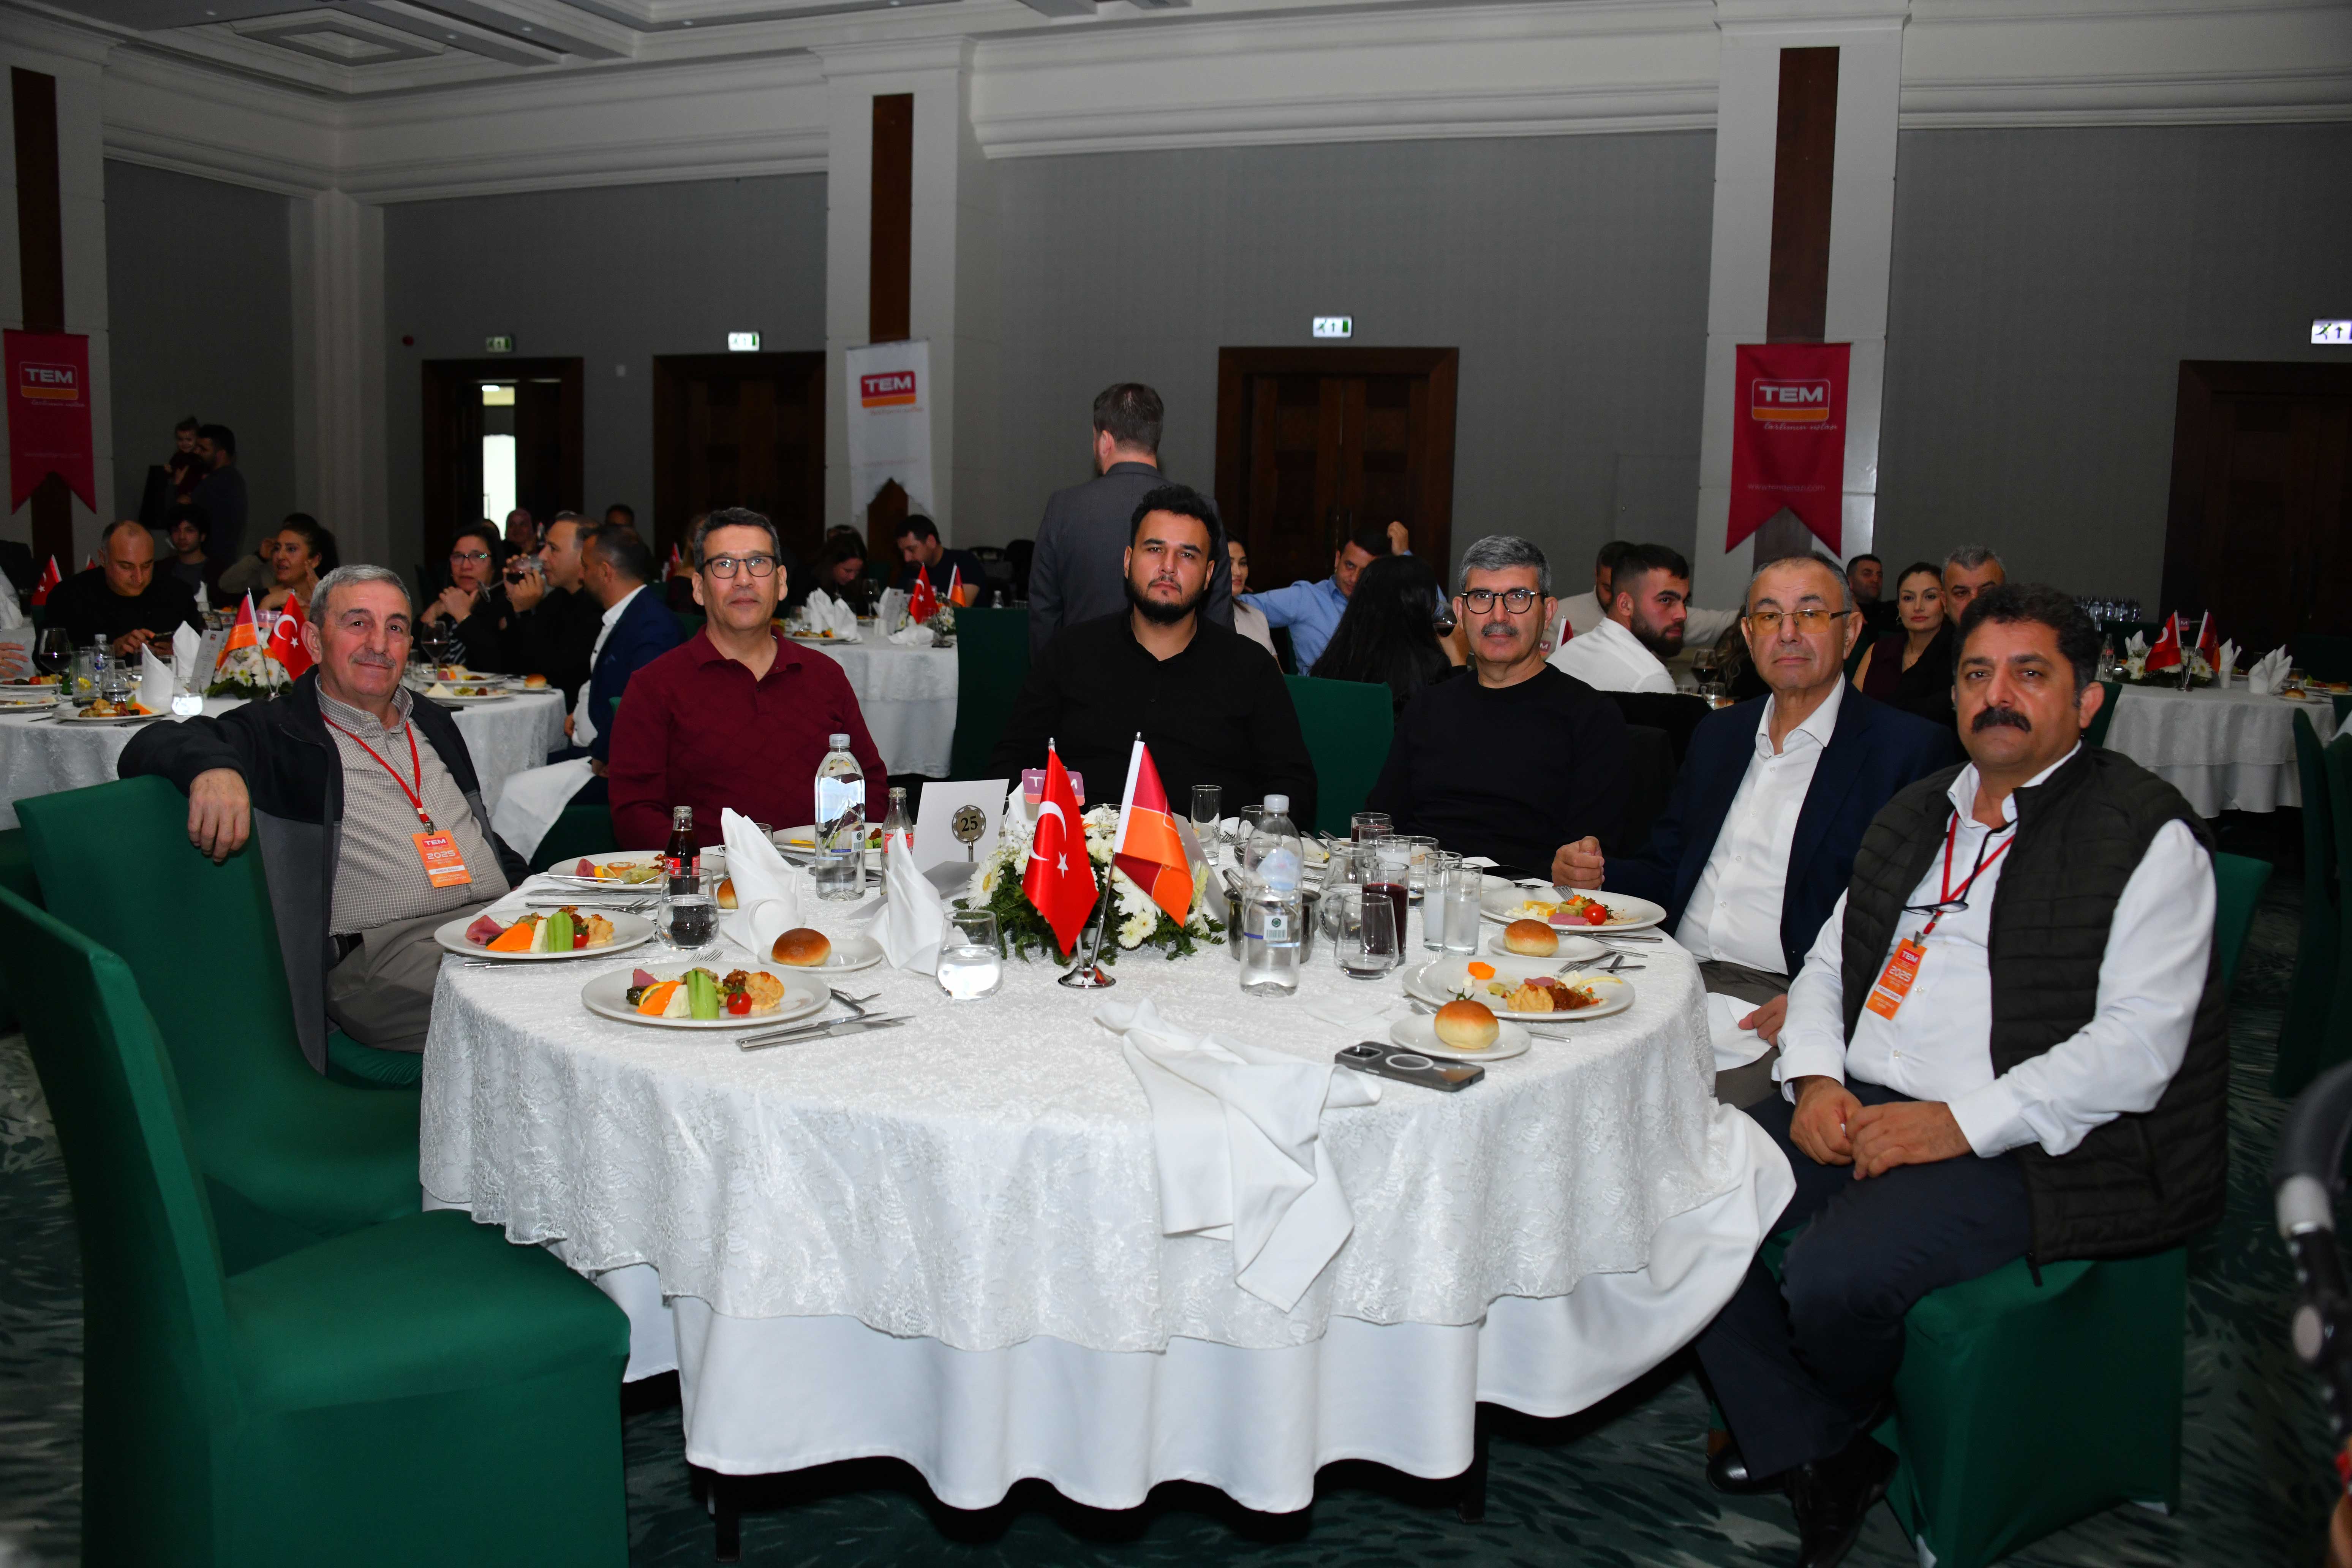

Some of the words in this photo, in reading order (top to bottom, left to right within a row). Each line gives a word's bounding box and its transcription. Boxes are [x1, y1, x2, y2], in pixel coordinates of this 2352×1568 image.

[24, 368, 73, 383] TEM
[865, 376, 912, 392] TEM
[1759, 386, 1823, 403] TEM
[961, 816, 978, 832] 25
[426, 850, 456, 860] 2025
[1902, 950, 1918, 963] TEM
[1889, 965, 1912, 982] 2025
